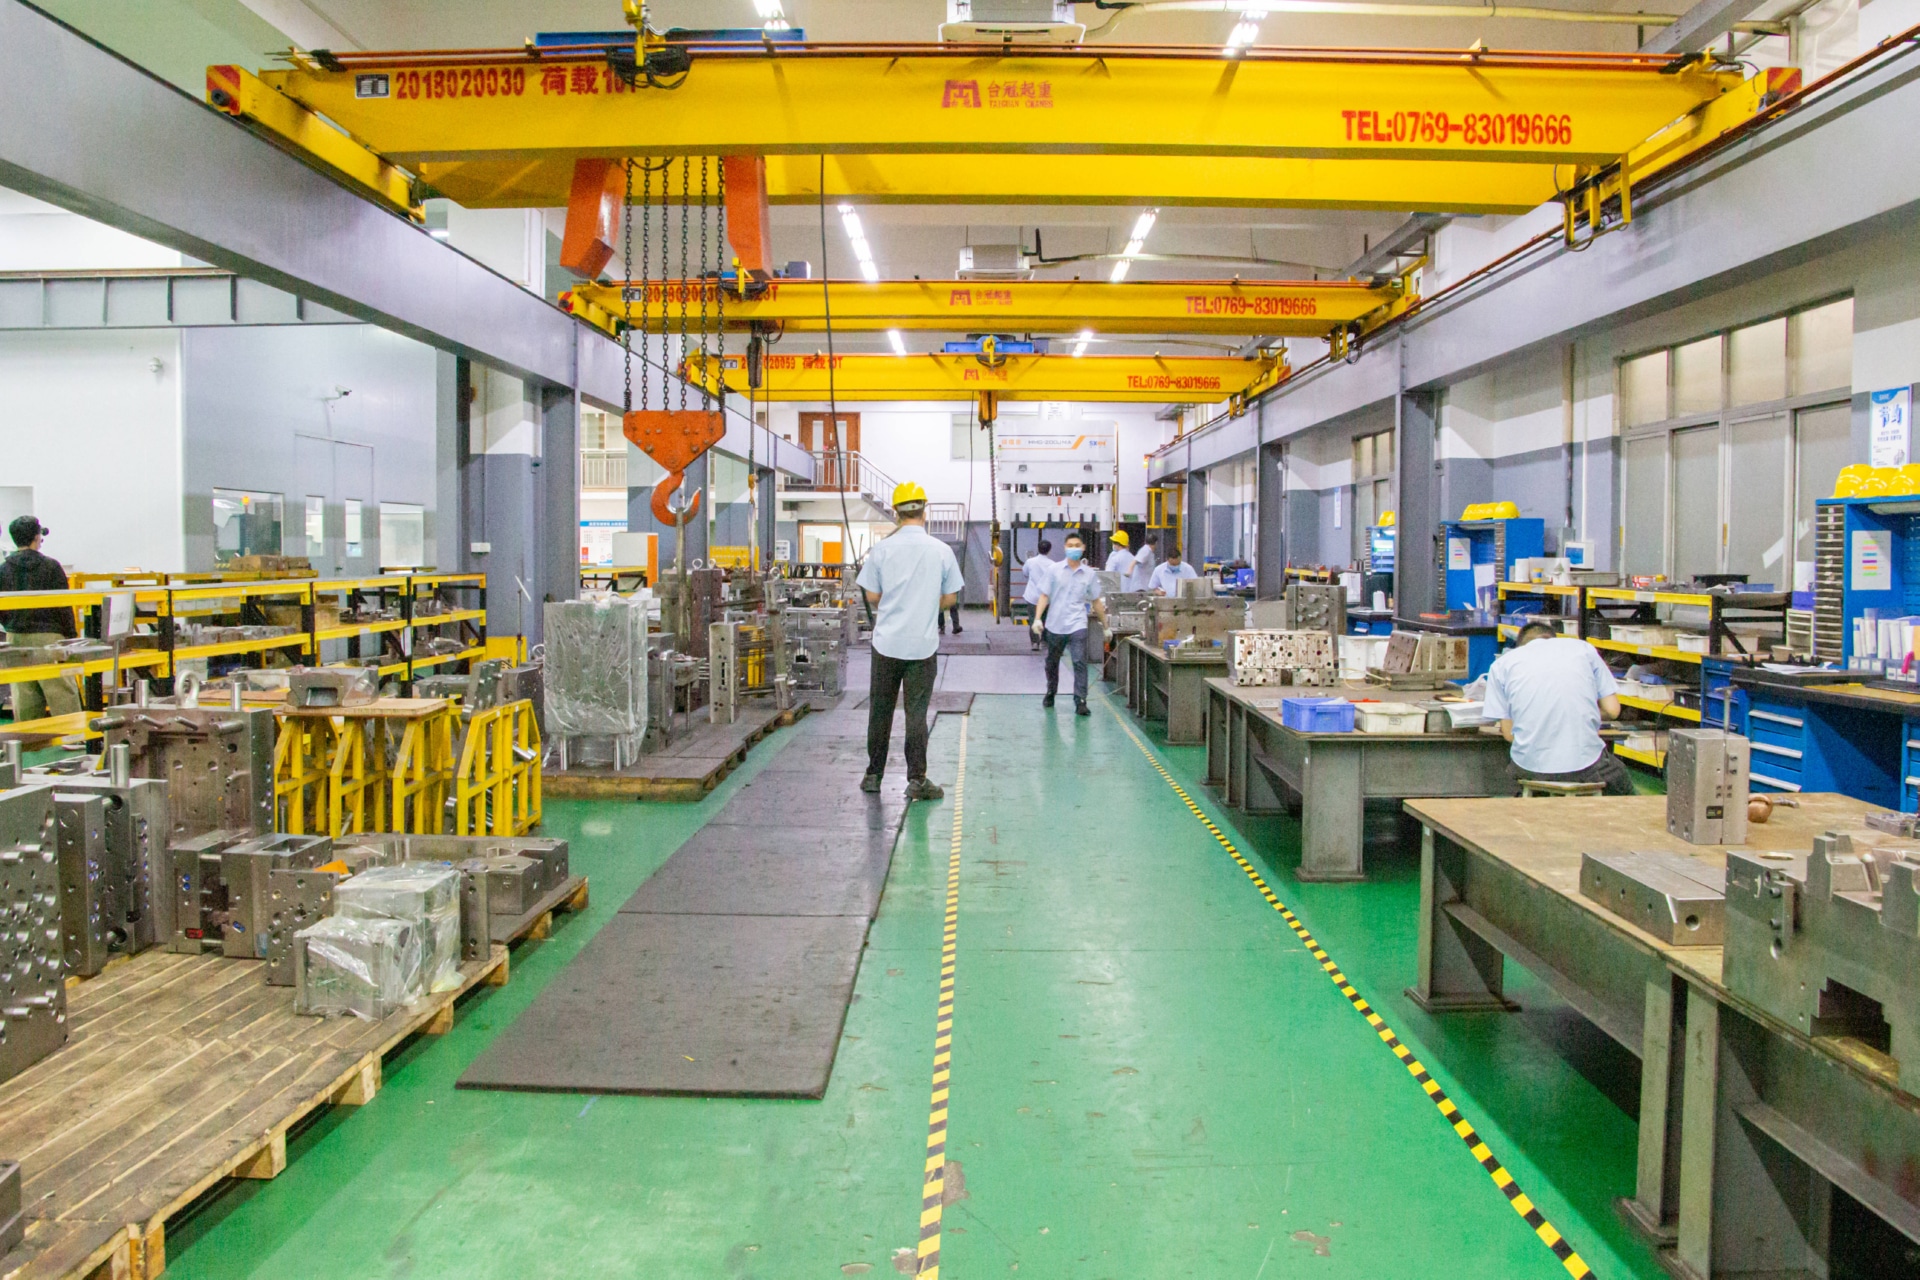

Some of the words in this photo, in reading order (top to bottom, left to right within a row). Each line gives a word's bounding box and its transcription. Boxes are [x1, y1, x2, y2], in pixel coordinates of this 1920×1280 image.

[987, 80, 1053, 98] 台冠起重
[1342, 110, 1572, 145] TEL:0769-83019666
[1186, 296, 1317, 315] TEL:0769-83019666
[1127, 375, 1221, 390] TEL:0769-83019666
